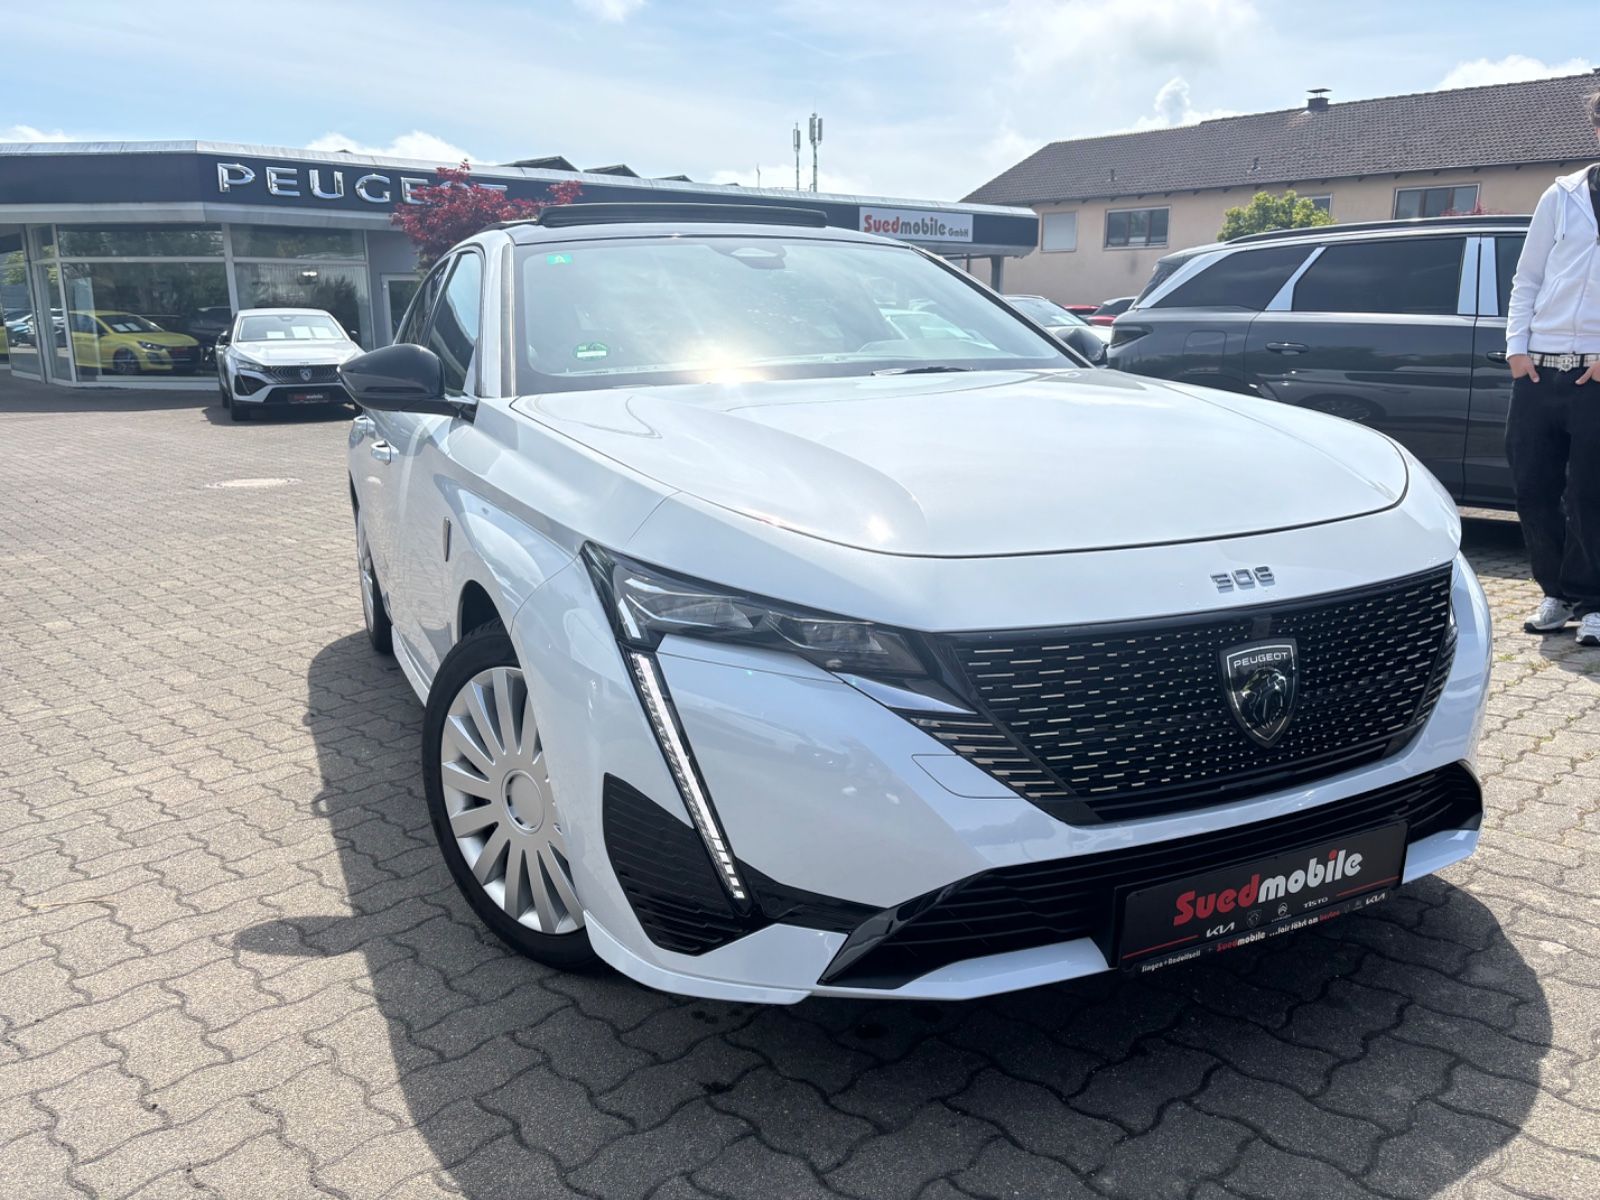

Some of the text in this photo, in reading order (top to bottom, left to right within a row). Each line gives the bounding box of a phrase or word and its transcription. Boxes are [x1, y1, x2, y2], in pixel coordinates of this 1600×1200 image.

[216, 162, 508, 205] PEUGE
[863, 214, 969, 238] Suedmobile GmbH
[1210, 566, 1275, 593] 308
[1233, 651, 1288, 668] PEUGEOT
[1173, 849, 1363, 926] Suedmobile
